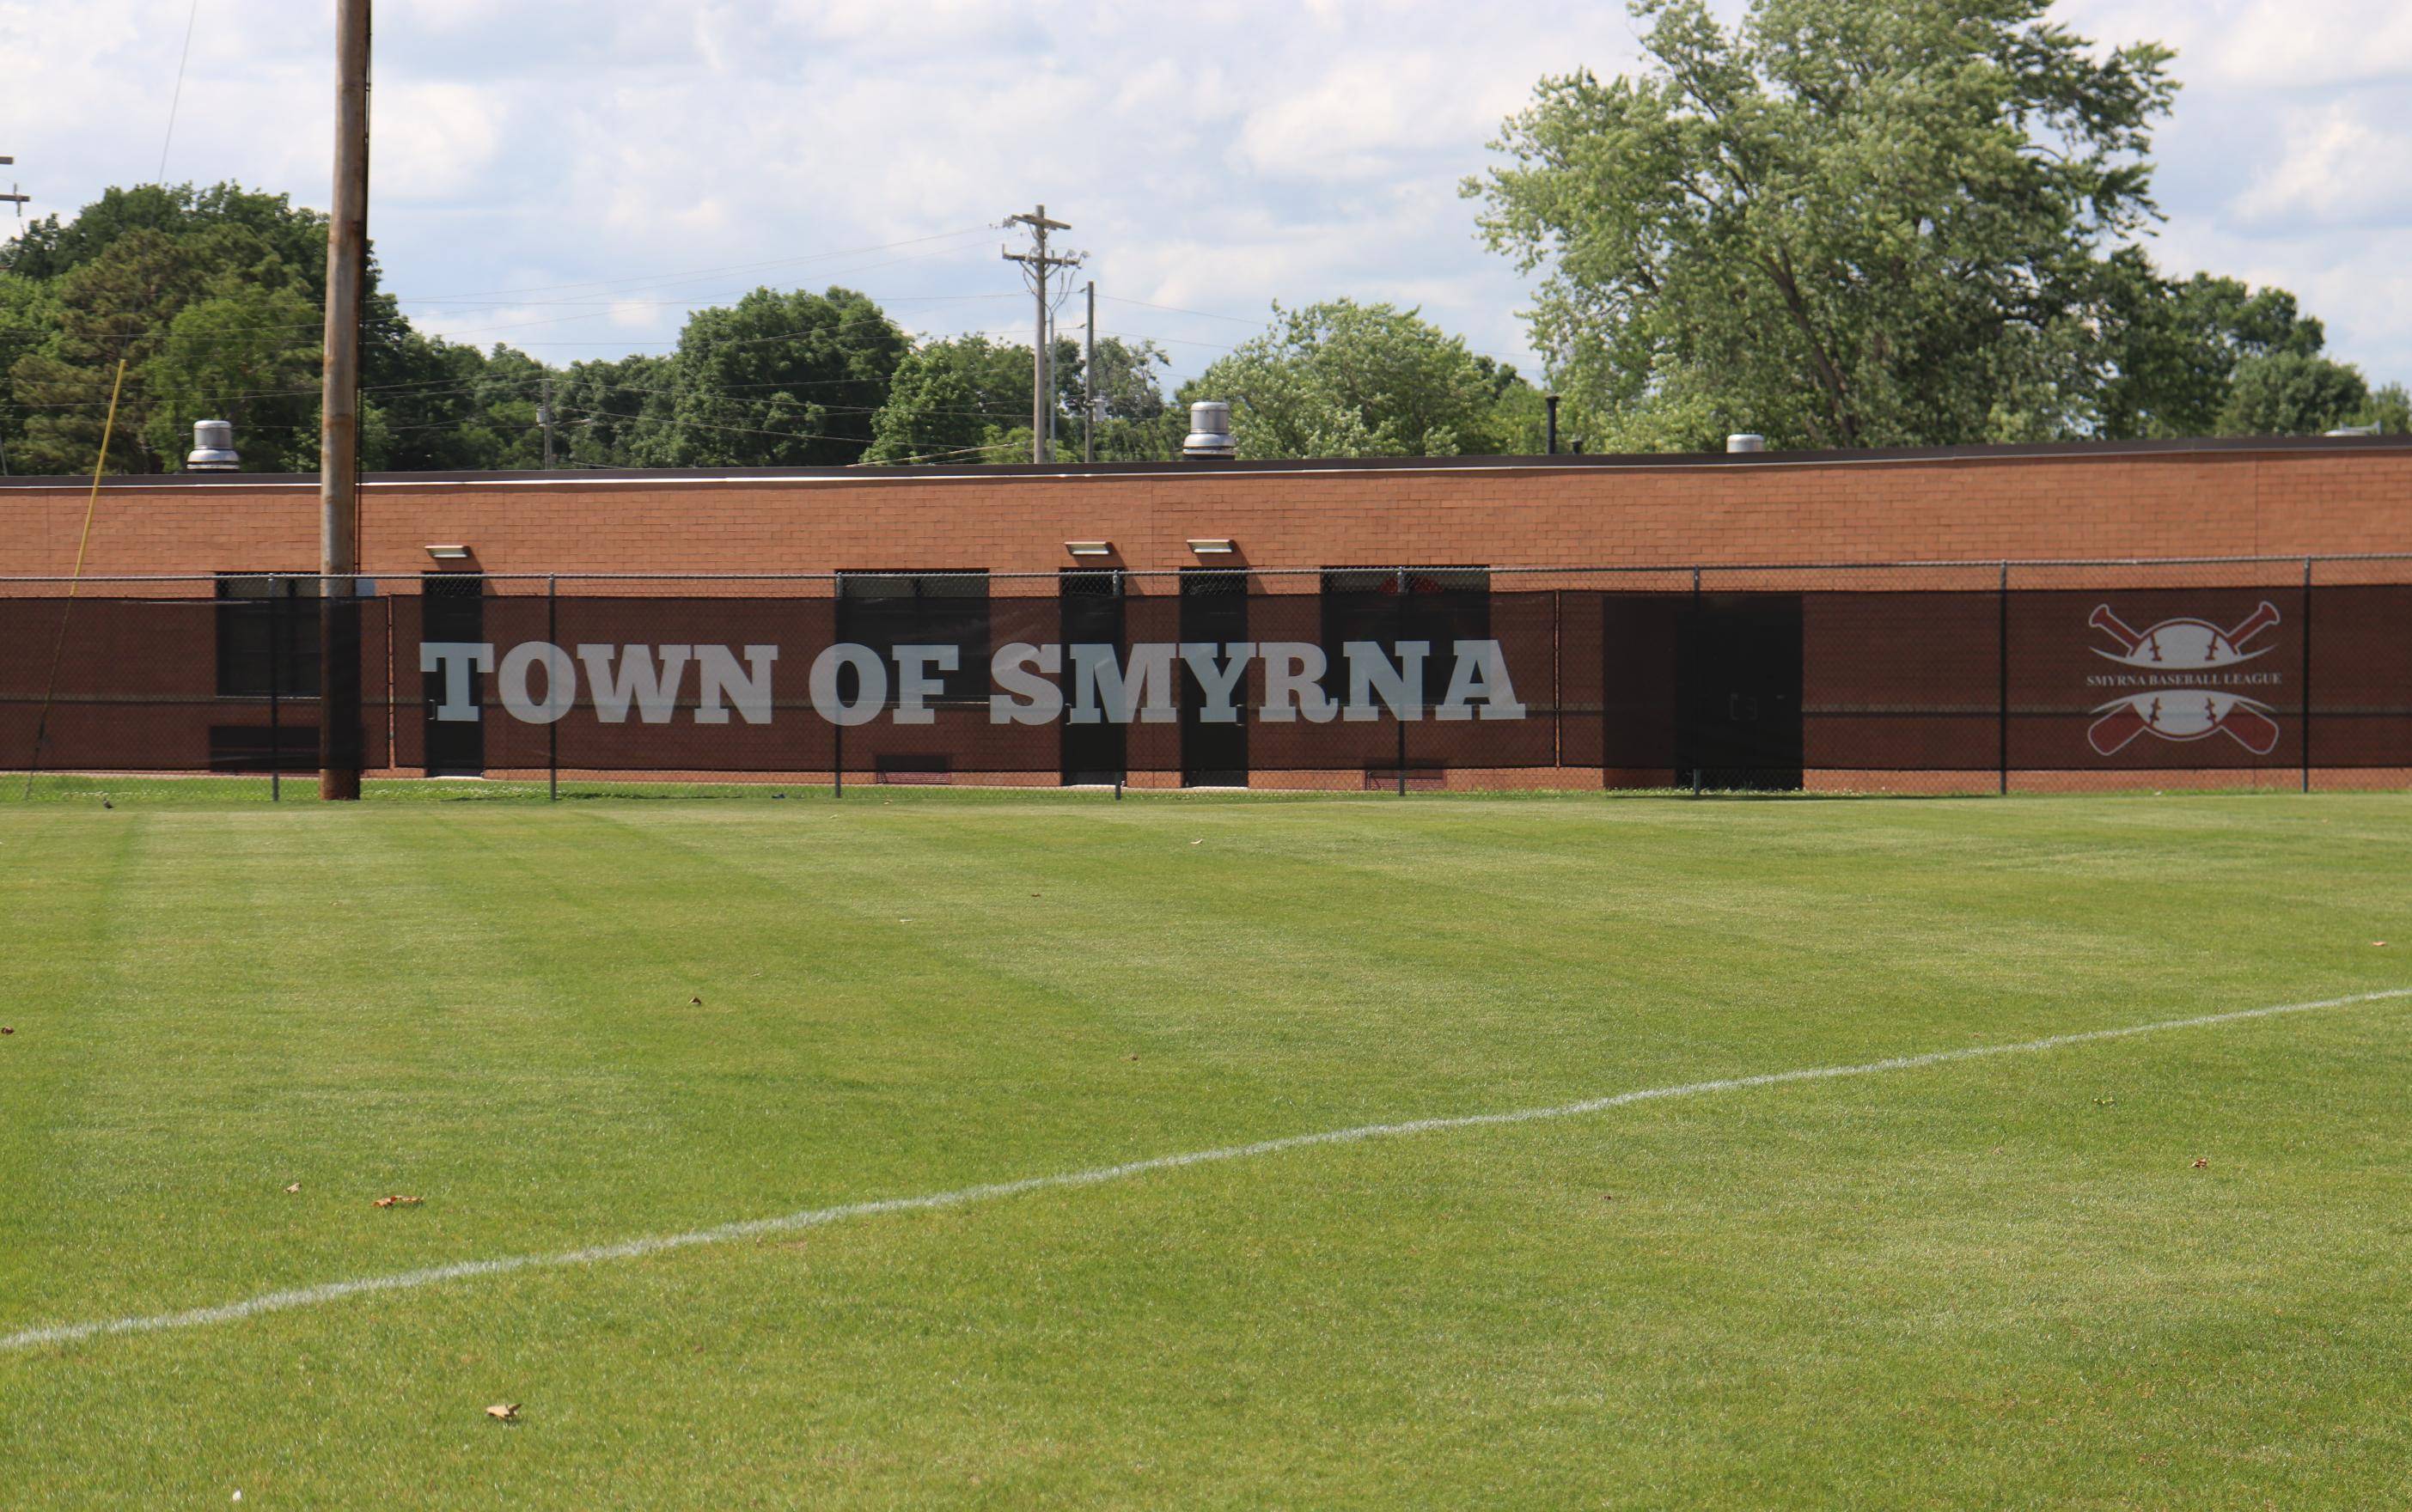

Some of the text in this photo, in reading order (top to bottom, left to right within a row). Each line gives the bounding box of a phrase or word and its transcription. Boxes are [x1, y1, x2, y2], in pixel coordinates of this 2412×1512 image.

[419, 639, 1526, 727] TOWN OF SMYRNA
[2086, 672, 2282, 686] SMYRNA BASEBALL LEAGUE
